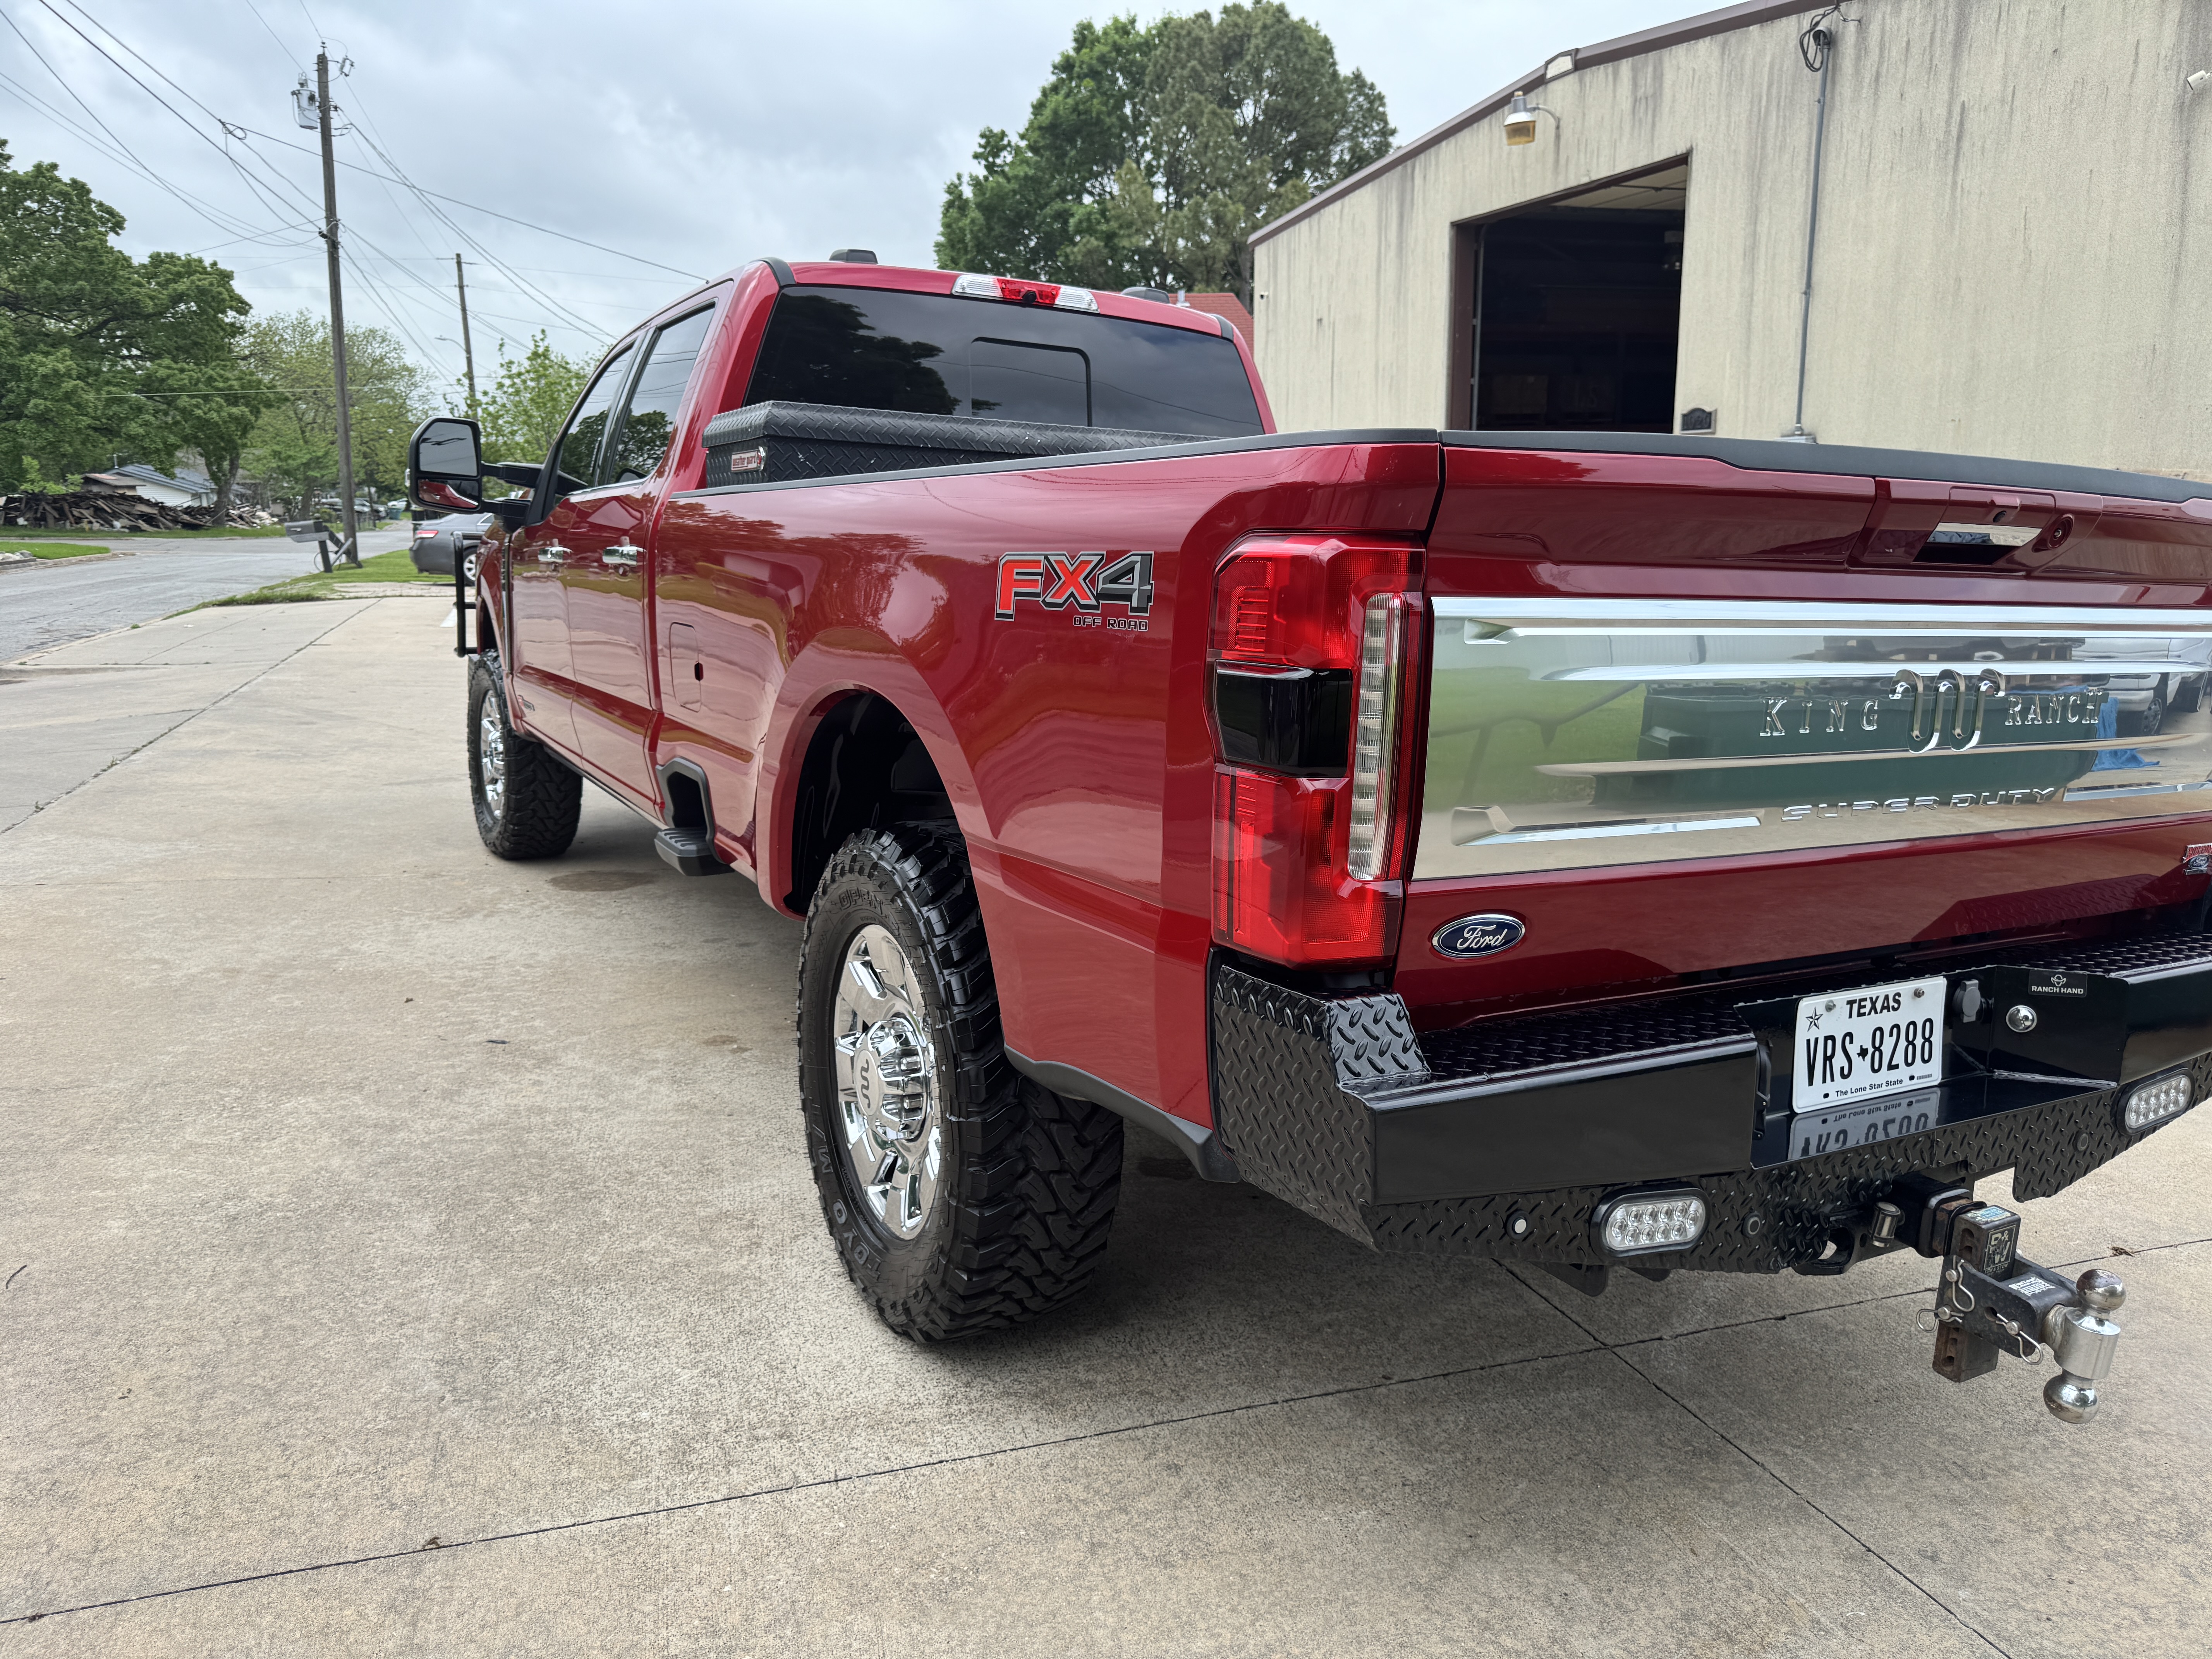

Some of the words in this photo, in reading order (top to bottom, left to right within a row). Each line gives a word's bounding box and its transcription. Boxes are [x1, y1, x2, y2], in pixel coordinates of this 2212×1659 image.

[995, 551, 1154, 621] FX4
[1073, 616, 1102, 628] OFF
[1107, 617, 1149, 632] ROAD
[1760, 696, 1879, 736] KING
[2004, 688, 2104, 725] RANCH
[1781, 796, 1939, 821] SUPER
[1949, 788, 2054, 809] DUTY
[1457, 924, 1508, 949] Ford
[1846, 992, 1901, 1019] TEXAS
[1806, 1032, 1854, 1087] VRS
[1870, 1018, 1934, 1074] 8288
[833, 1199, 881, 1281] TOYO
